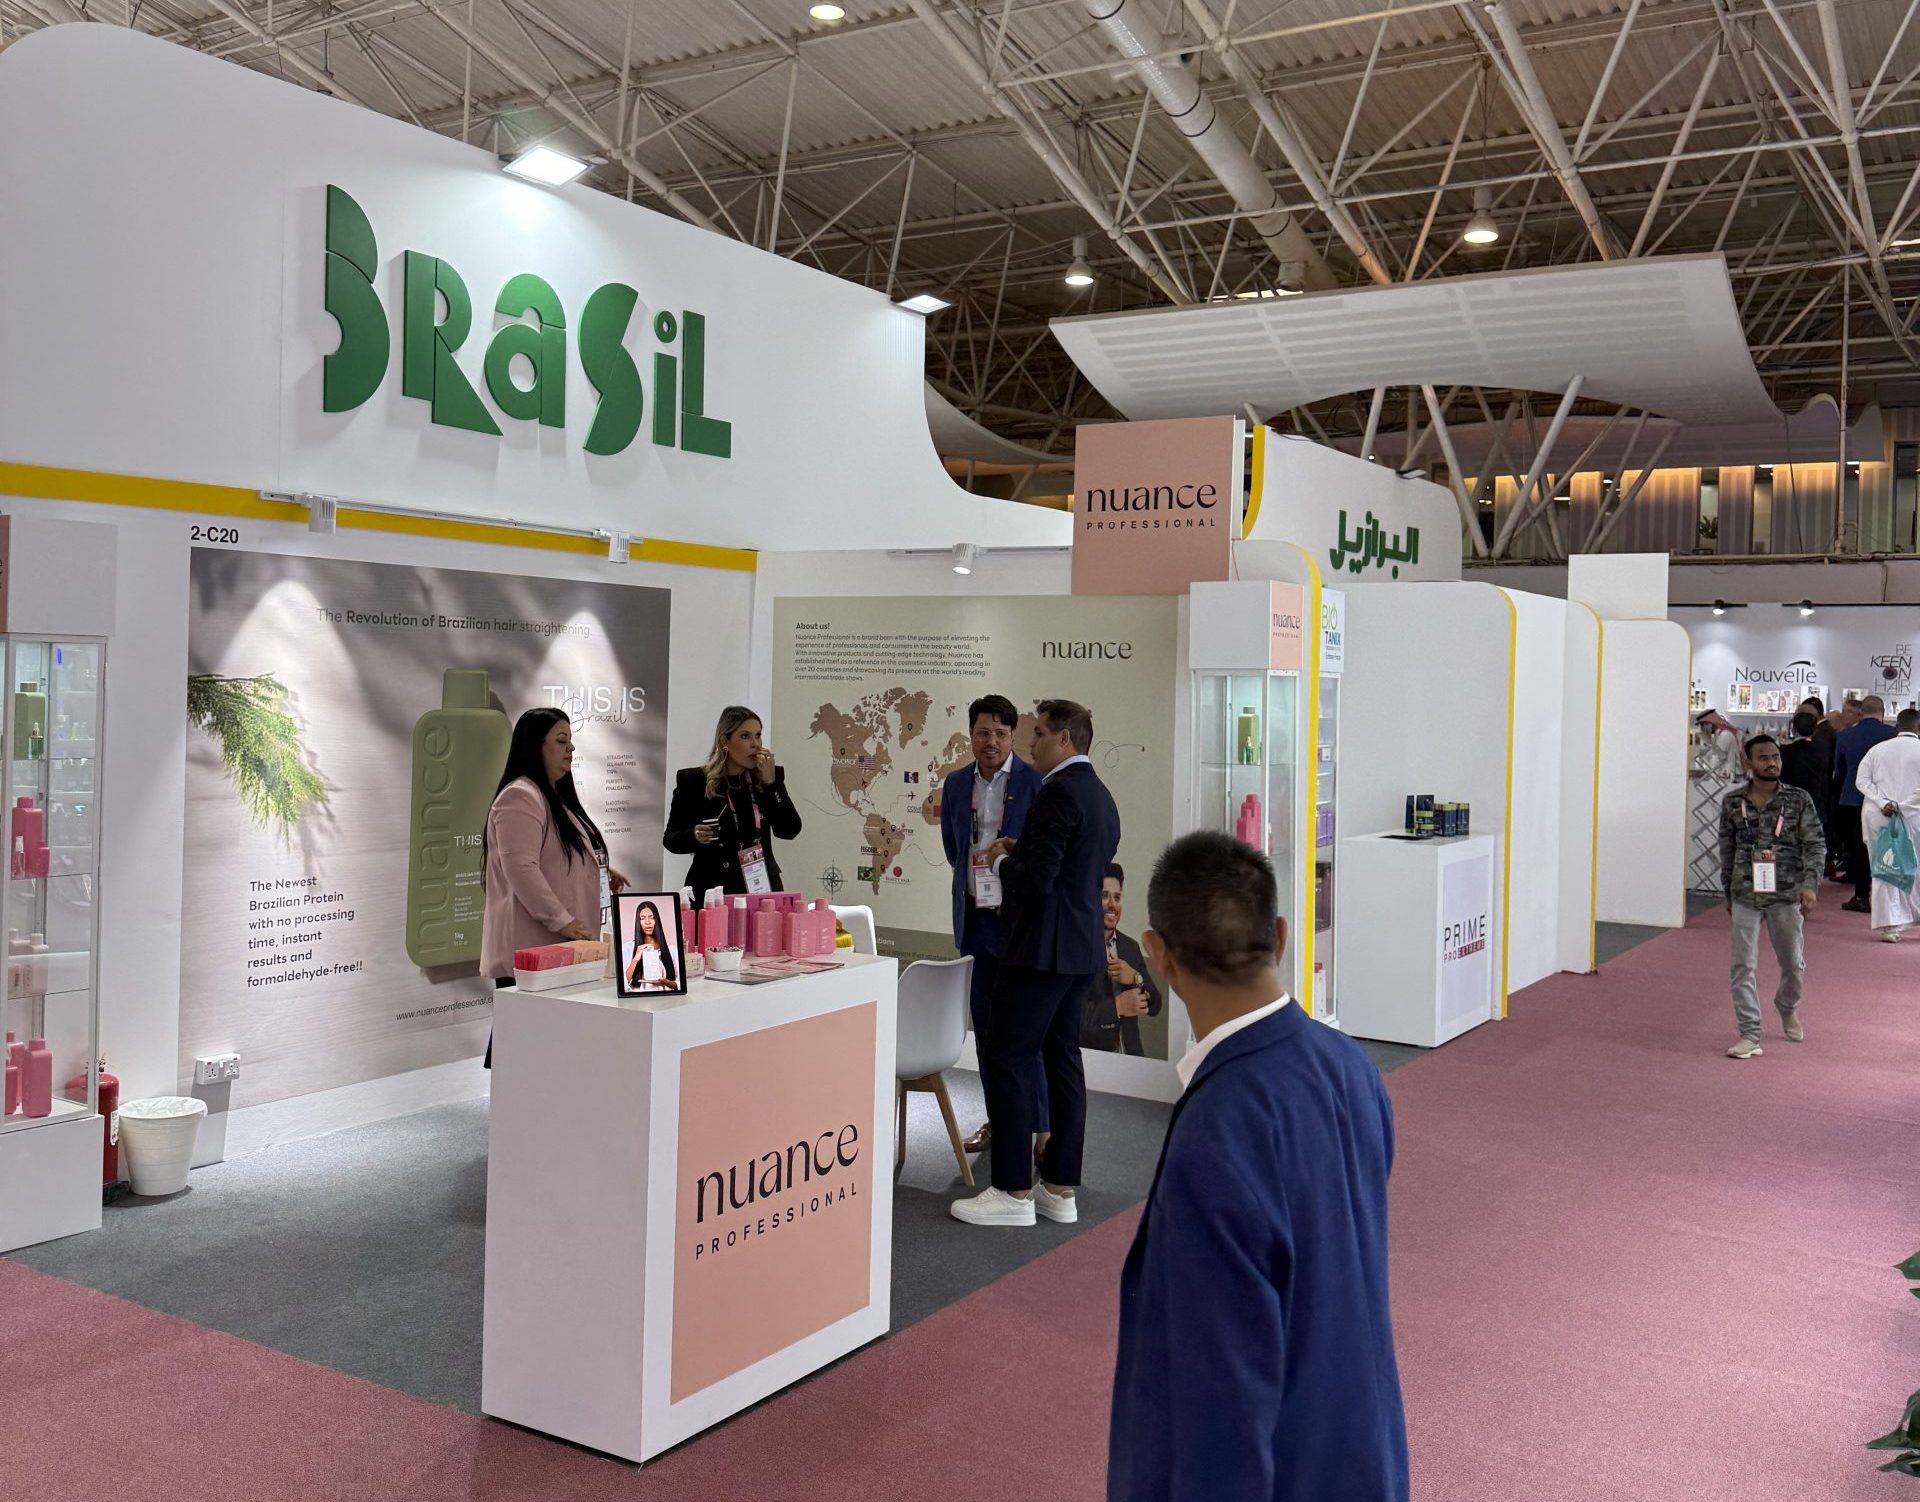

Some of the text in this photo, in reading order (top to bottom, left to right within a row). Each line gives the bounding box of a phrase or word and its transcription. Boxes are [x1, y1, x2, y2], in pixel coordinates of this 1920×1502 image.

[1087, 484, 1218, 512] nuance
[1086, 518, 1215, 530] PROFESSIONAL
[190, 525, 239, 544] 2-C20
[1329, 510, 1419, 579] البرازيل
[317, 608, 592, 638] The Revolution of Brazilian hair straightening.
[1273, 614, 1300, 629] nuance
[1322, 603, 1338, 630] BIO
[951, 635, 978, 643] elevating
[1042, 641, 1132, 660] nuance
[1896, 644, 1912, 656] BE
[1870, 655, 1912, 668] KEEN
[1735, 667, 1817, 684] Nouvelle
[1875, 679, 1910, 692] HAIR
[544, 686, 645, 712] THIS IS
[561, 692, 627, 733] Brazil
[417, 725, 453, 954] nuance
[453, 834, 482, 847] THIS
[250, 876, 317, 892] The Newest
[249, 891, 344, 911] Brazilian Protein
[249, 909, 355, 930] with no processing
[248, 931, 322, 949] time, instant
[1444, 915, 1485, 951] PRIME
[247, 949, 312, 968] results and
[247, 960, 363, 987] formaldehyde-free!!
[396, 997, 493, 1020] www.nuanceprofessional.c
[696, 1124, 859, 1224] nuance
[696, 1182, 857, 1260] PROFESSIONAL
